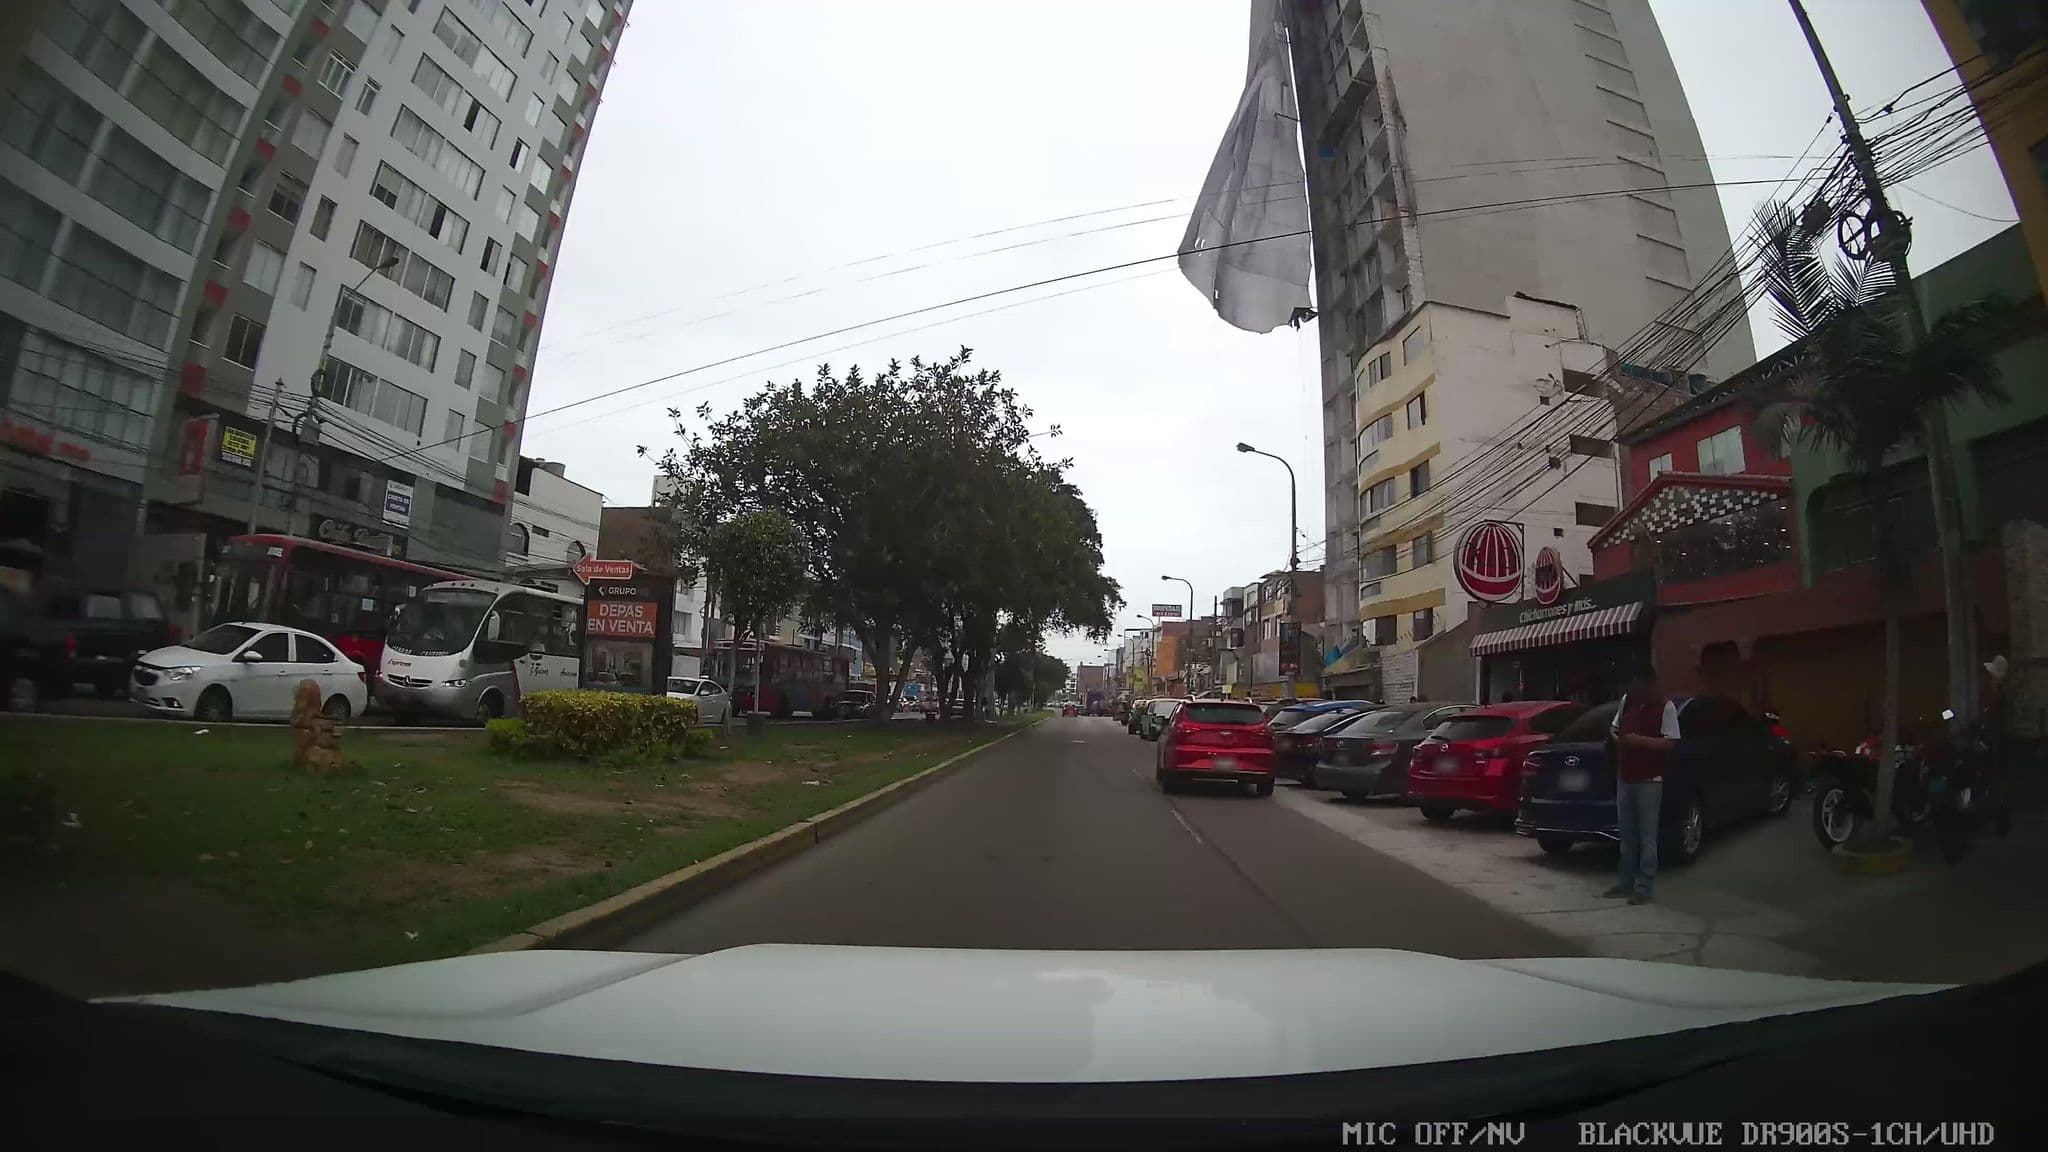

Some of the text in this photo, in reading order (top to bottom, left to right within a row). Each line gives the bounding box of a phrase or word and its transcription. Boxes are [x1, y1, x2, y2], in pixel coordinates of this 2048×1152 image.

[576, 564, 630, 575] Sala de Ventas
[608, 586, 637, 595] GRUPO
[599, 603, 644, 618] DEPAS
[587, 618, 654, 635] EN VENTA
